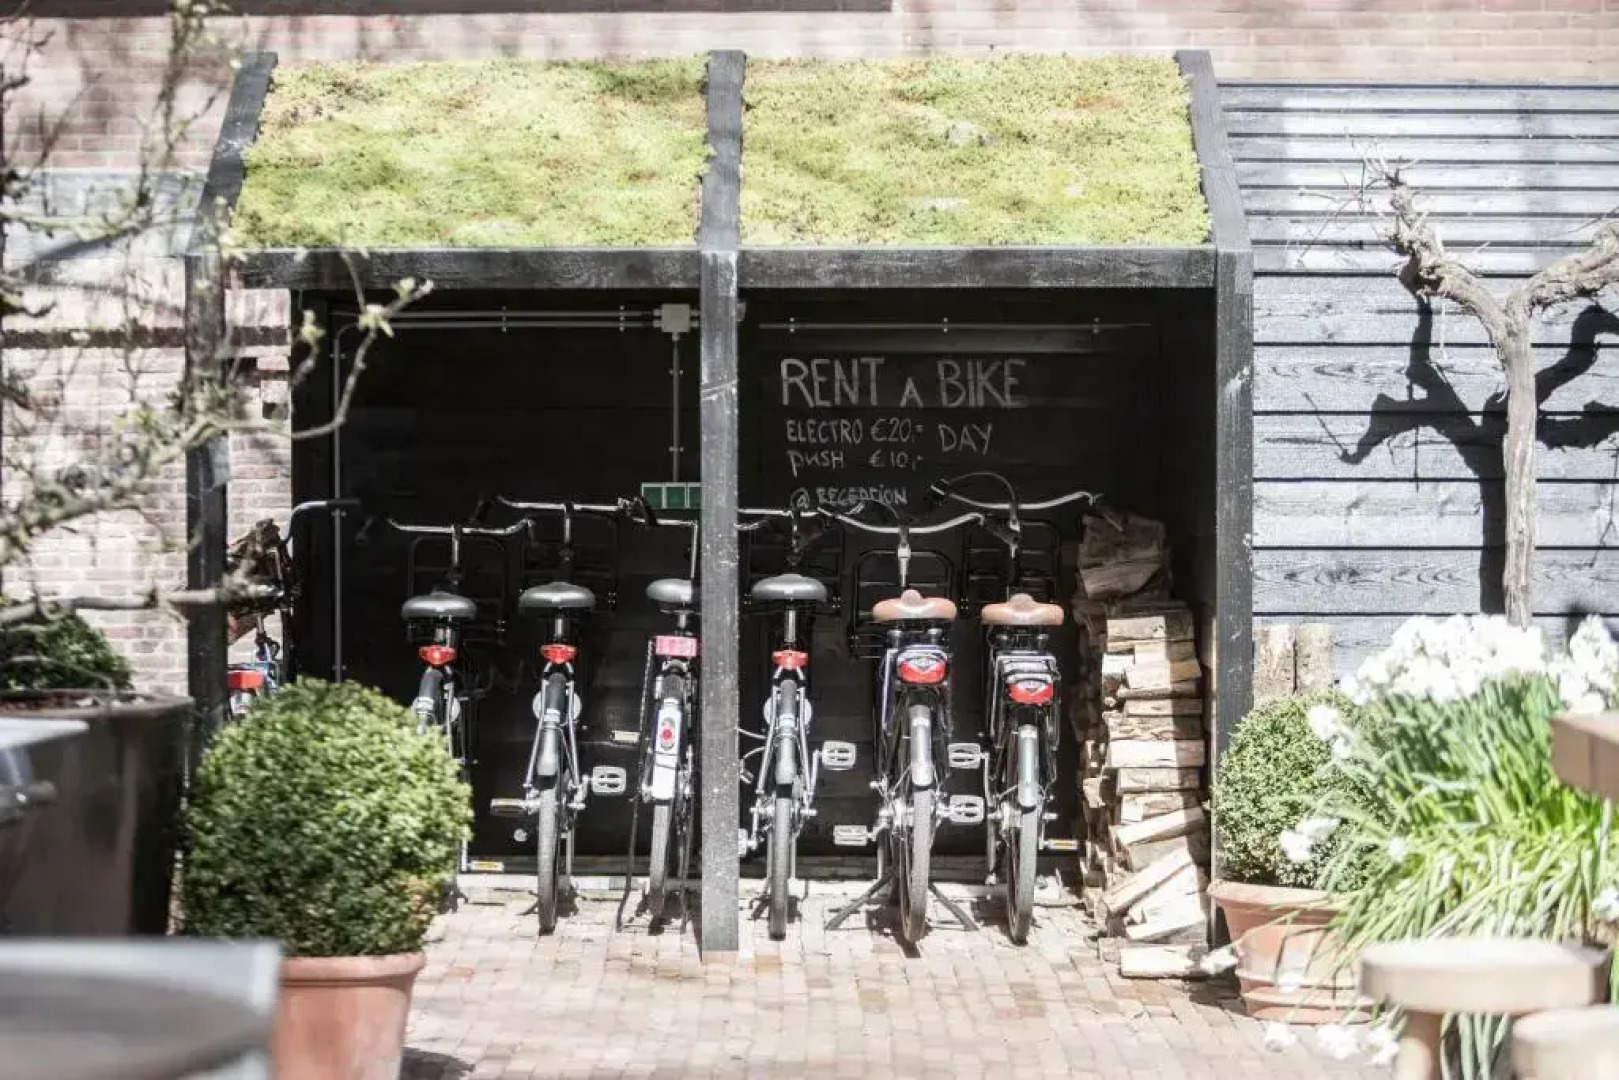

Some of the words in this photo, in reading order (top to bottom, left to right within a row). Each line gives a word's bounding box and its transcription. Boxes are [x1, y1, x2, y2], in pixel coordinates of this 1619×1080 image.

[780, 357, 885, 408] RENT
[900, 377, 924, 408] A
[936, 359, 1027, 408] BIKE
[786, 418, 863, 444] ELECTRO
[938, 423, 992, 456] DAY
[790, 487, 811, 510] @
